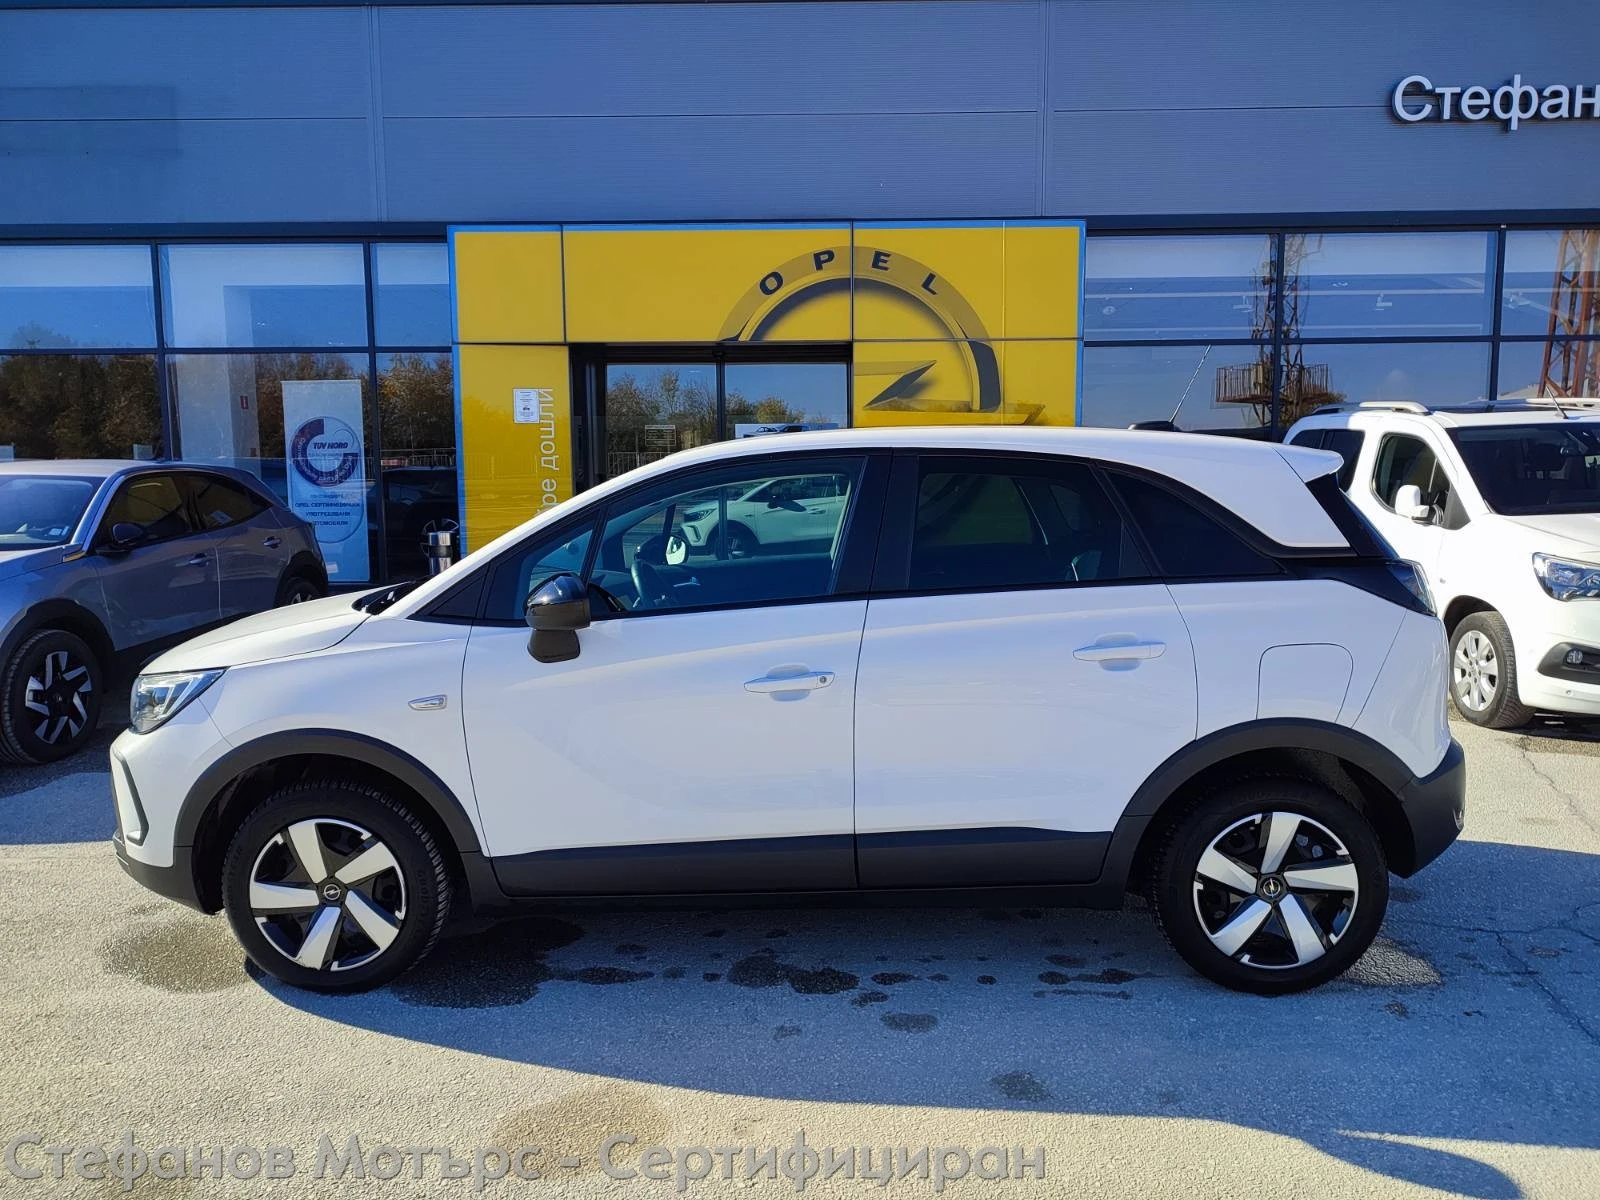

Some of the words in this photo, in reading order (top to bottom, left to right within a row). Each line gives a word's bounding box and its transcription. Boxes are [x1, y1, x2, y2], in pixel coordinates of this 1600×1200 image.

[1394, 74, 1600, 130] Стефан
[759, 249, 939, 296] OPEL
[538, 388, 560, 471] дошли
